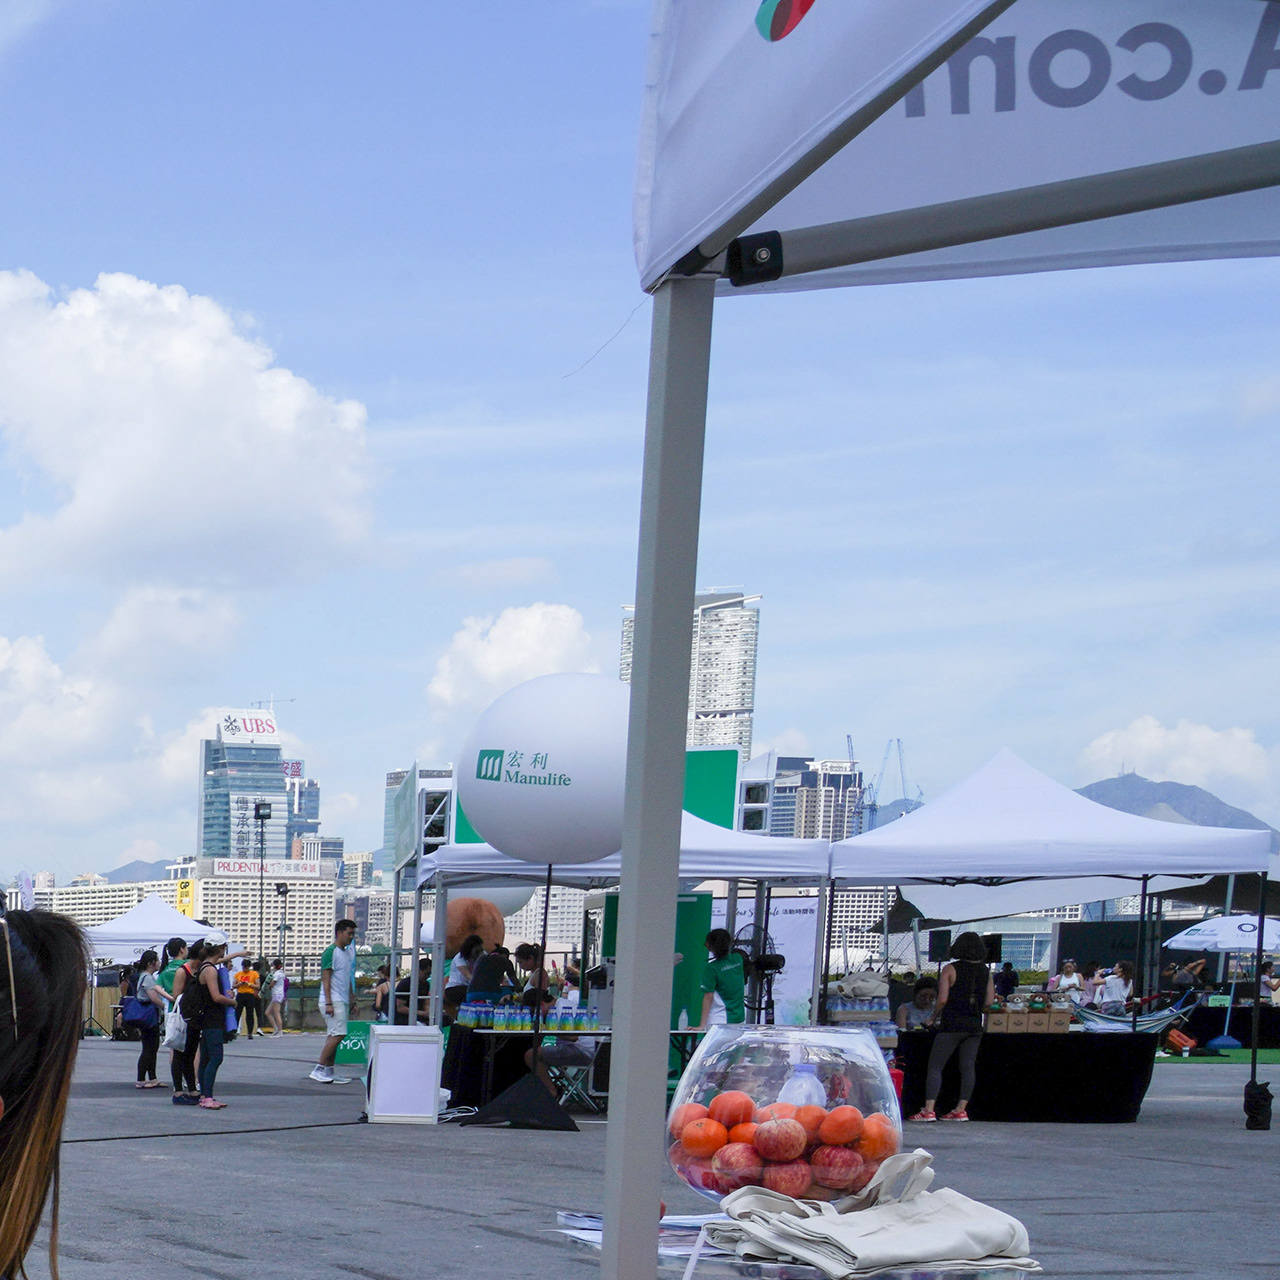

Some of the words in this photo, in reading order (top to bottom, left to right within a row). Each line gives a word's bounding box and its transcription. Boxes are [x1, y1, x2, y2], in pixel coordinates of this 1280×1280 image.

[242, 718, 275, 734] UBS
[506, 751, 548, 770] 宏利
[504, 770, 572, 786] Manulife
[218, 861, 269, 873] PRUDENTIAL
[286, 863, 317, 874] 英國保誠
[180, 881, 190, 890] GP
